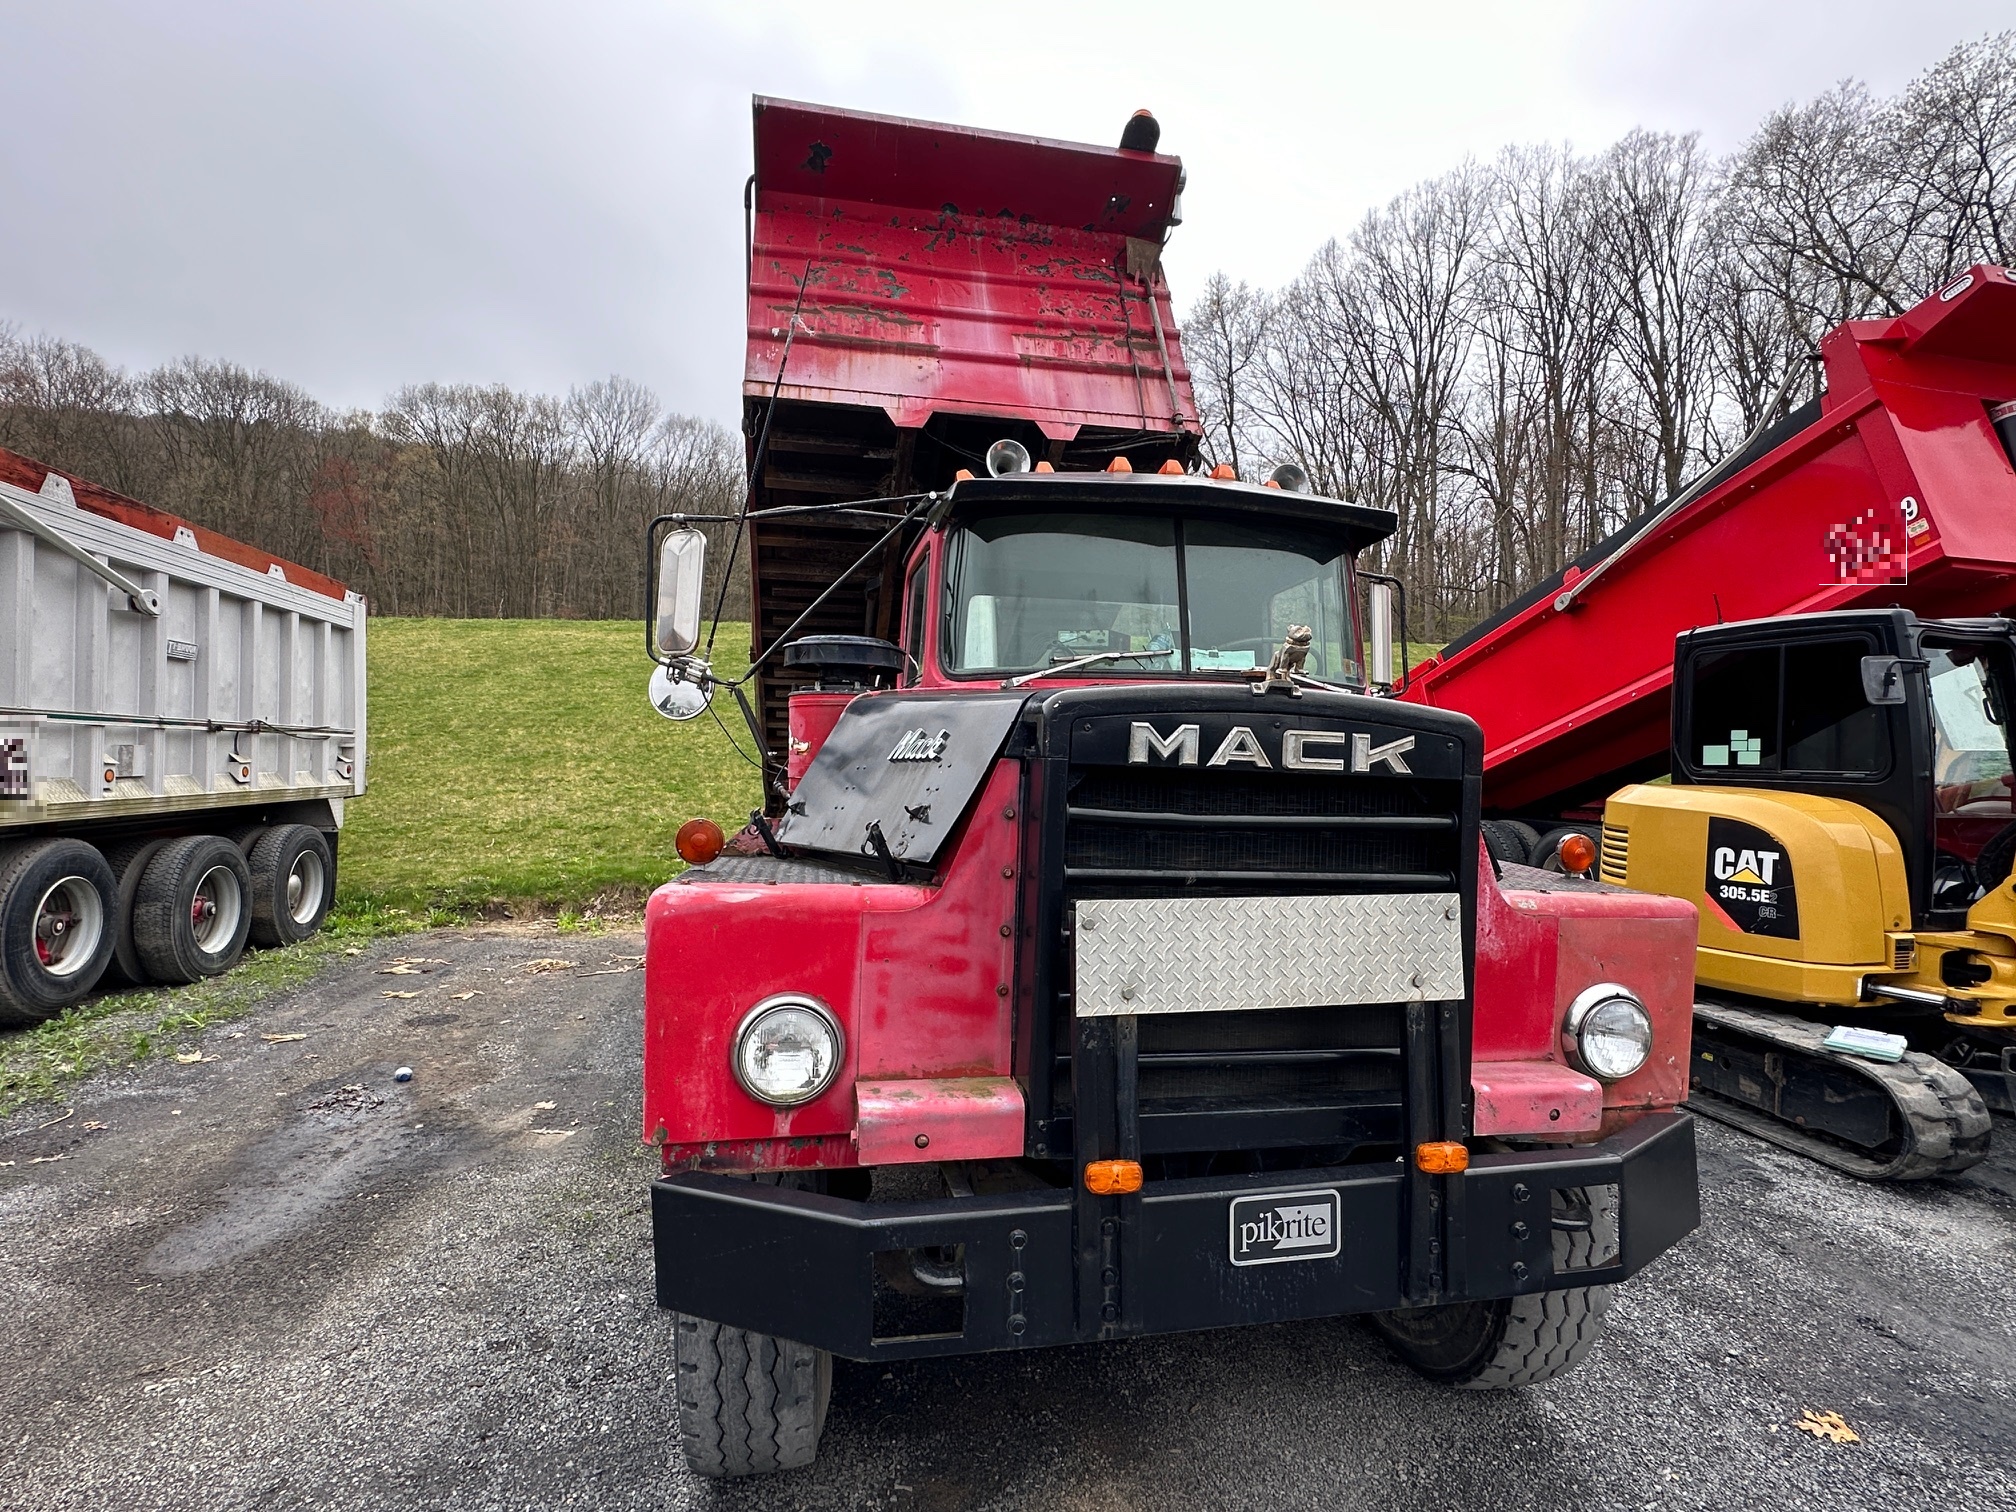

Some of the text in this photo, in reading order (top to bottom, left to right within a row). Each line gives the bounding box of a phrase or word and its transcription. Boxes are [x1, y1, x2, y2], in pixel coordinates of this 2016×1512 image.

[887, 727, 949, 761] Mack
[1128, 721, 1415, 775] MACK
[1714, 847, 1779, 885] CAT
[1758, 906, 1777, 918] CR
[1240, 1210, 1327, 1252] pikrite
